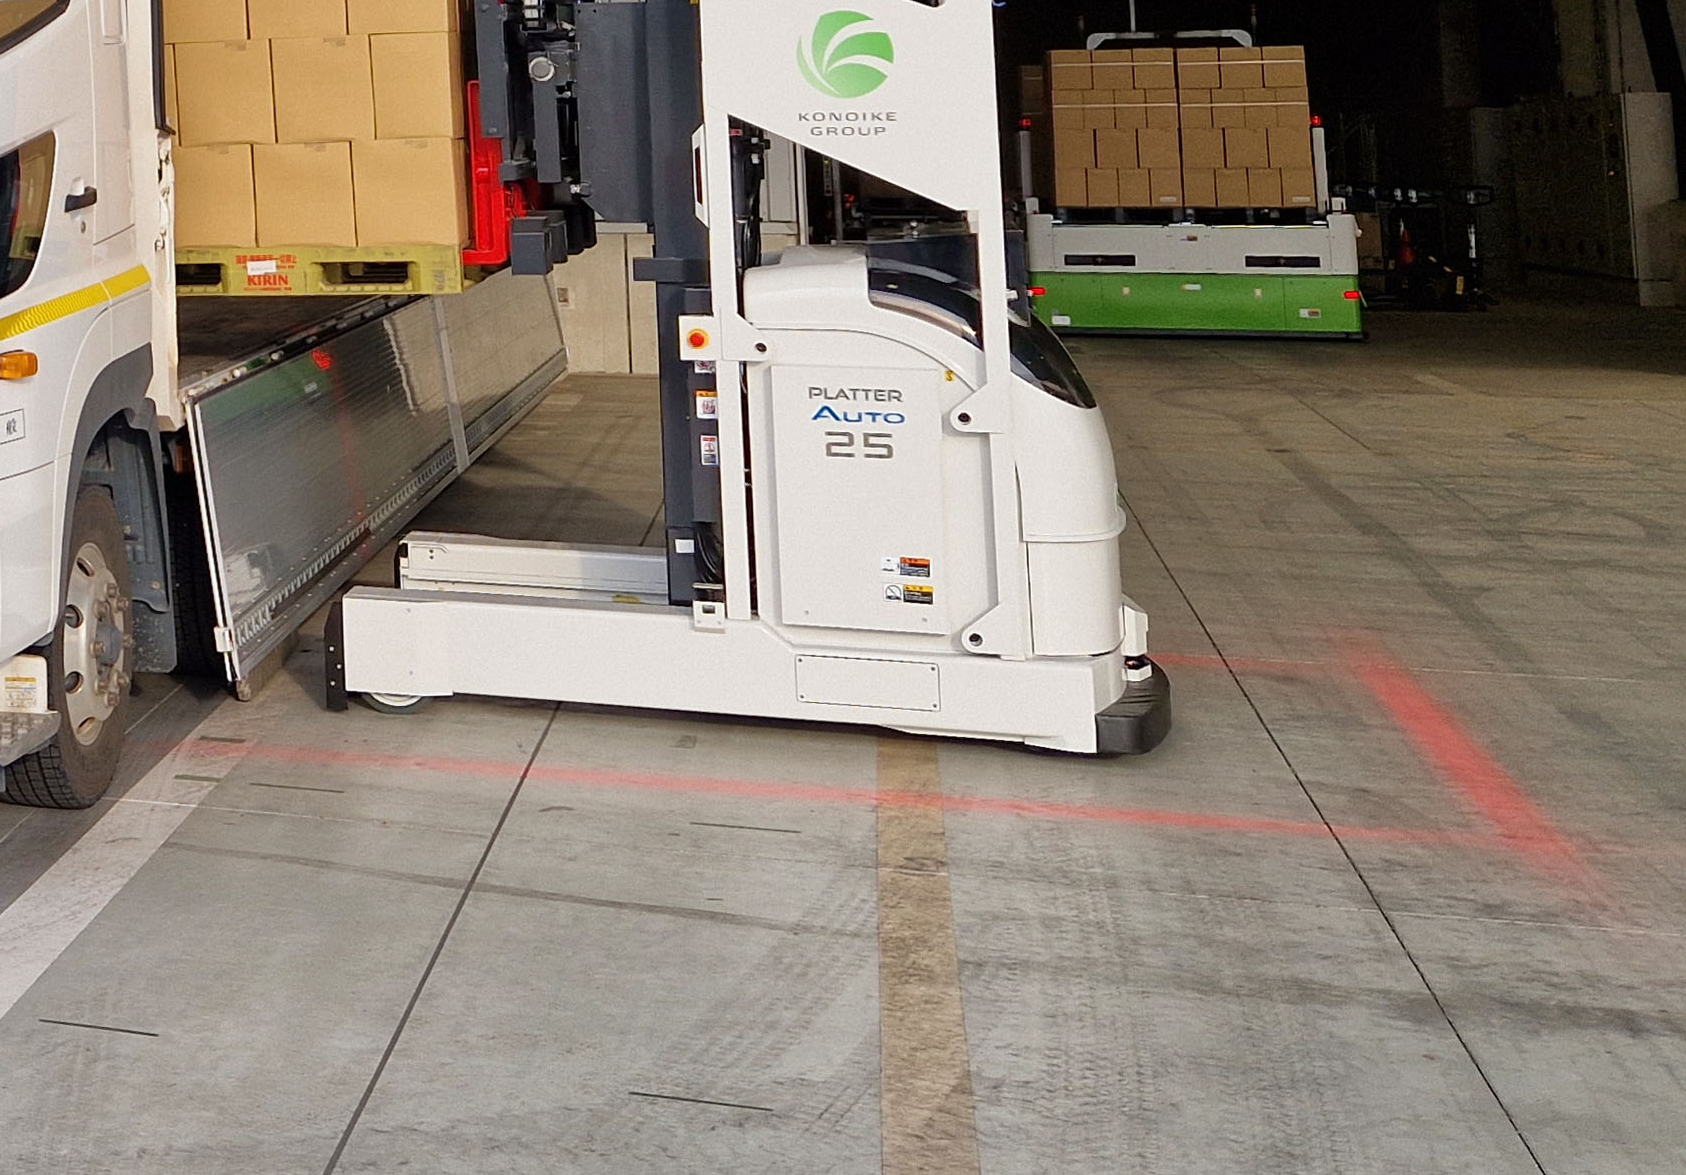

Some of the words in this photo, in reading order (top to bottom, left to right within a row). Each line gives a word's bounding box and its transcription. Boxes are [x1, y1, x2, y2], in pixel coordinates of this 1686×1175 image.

[798, 111, 898, 122] KONOIKE
[810, 126, 887, 136] GROUP
[247, 275, 289, 286] KIRIN
[808, 386, 904, 402] PLATTER
[824, 431, 894, 459] 25
